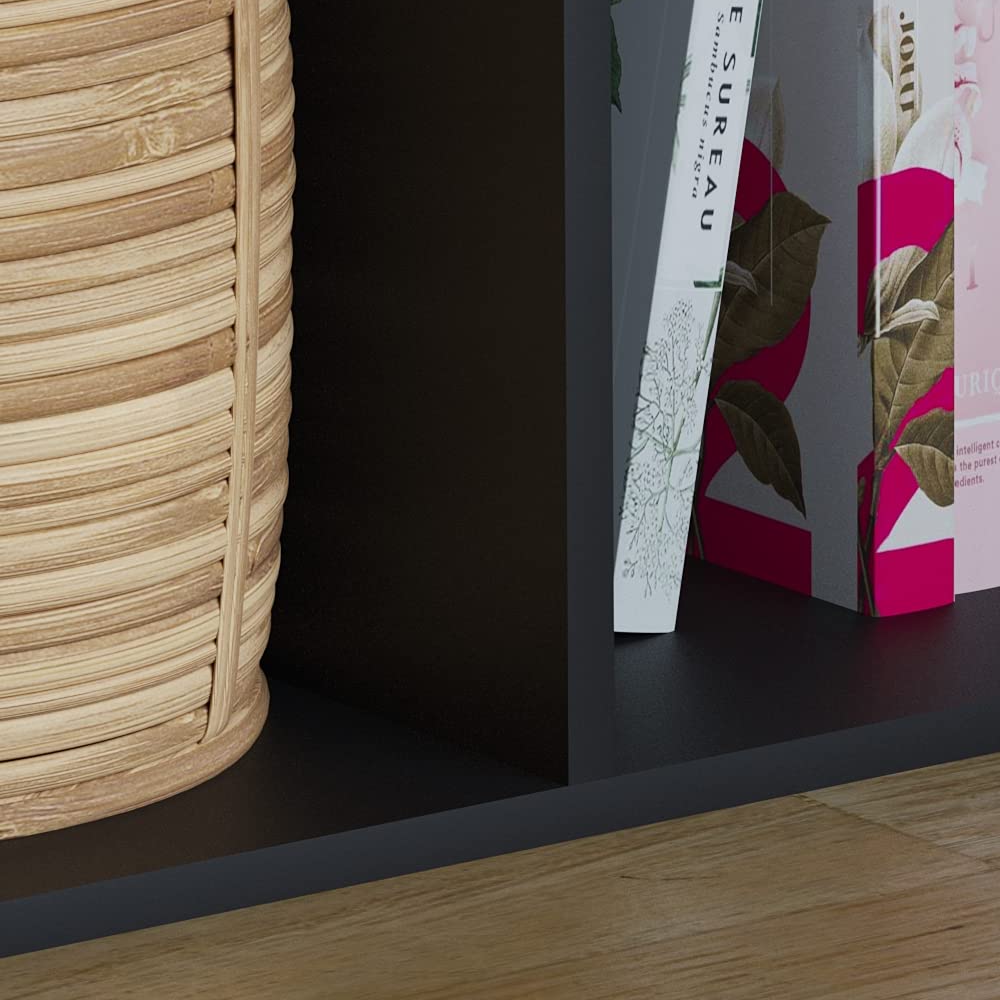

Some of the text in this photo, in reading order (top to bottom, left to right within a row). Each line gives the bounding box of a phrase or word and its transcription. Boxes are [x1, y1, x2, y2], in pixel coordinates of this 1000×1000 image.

[692, 11, 725, 198] Sambucus nigra
[700, 52, 736, 231] SUREAU
[956, 440, 994, 456] intelligent
[960, 459, 972, 471] the
[974, 456, 997, 473] purest
